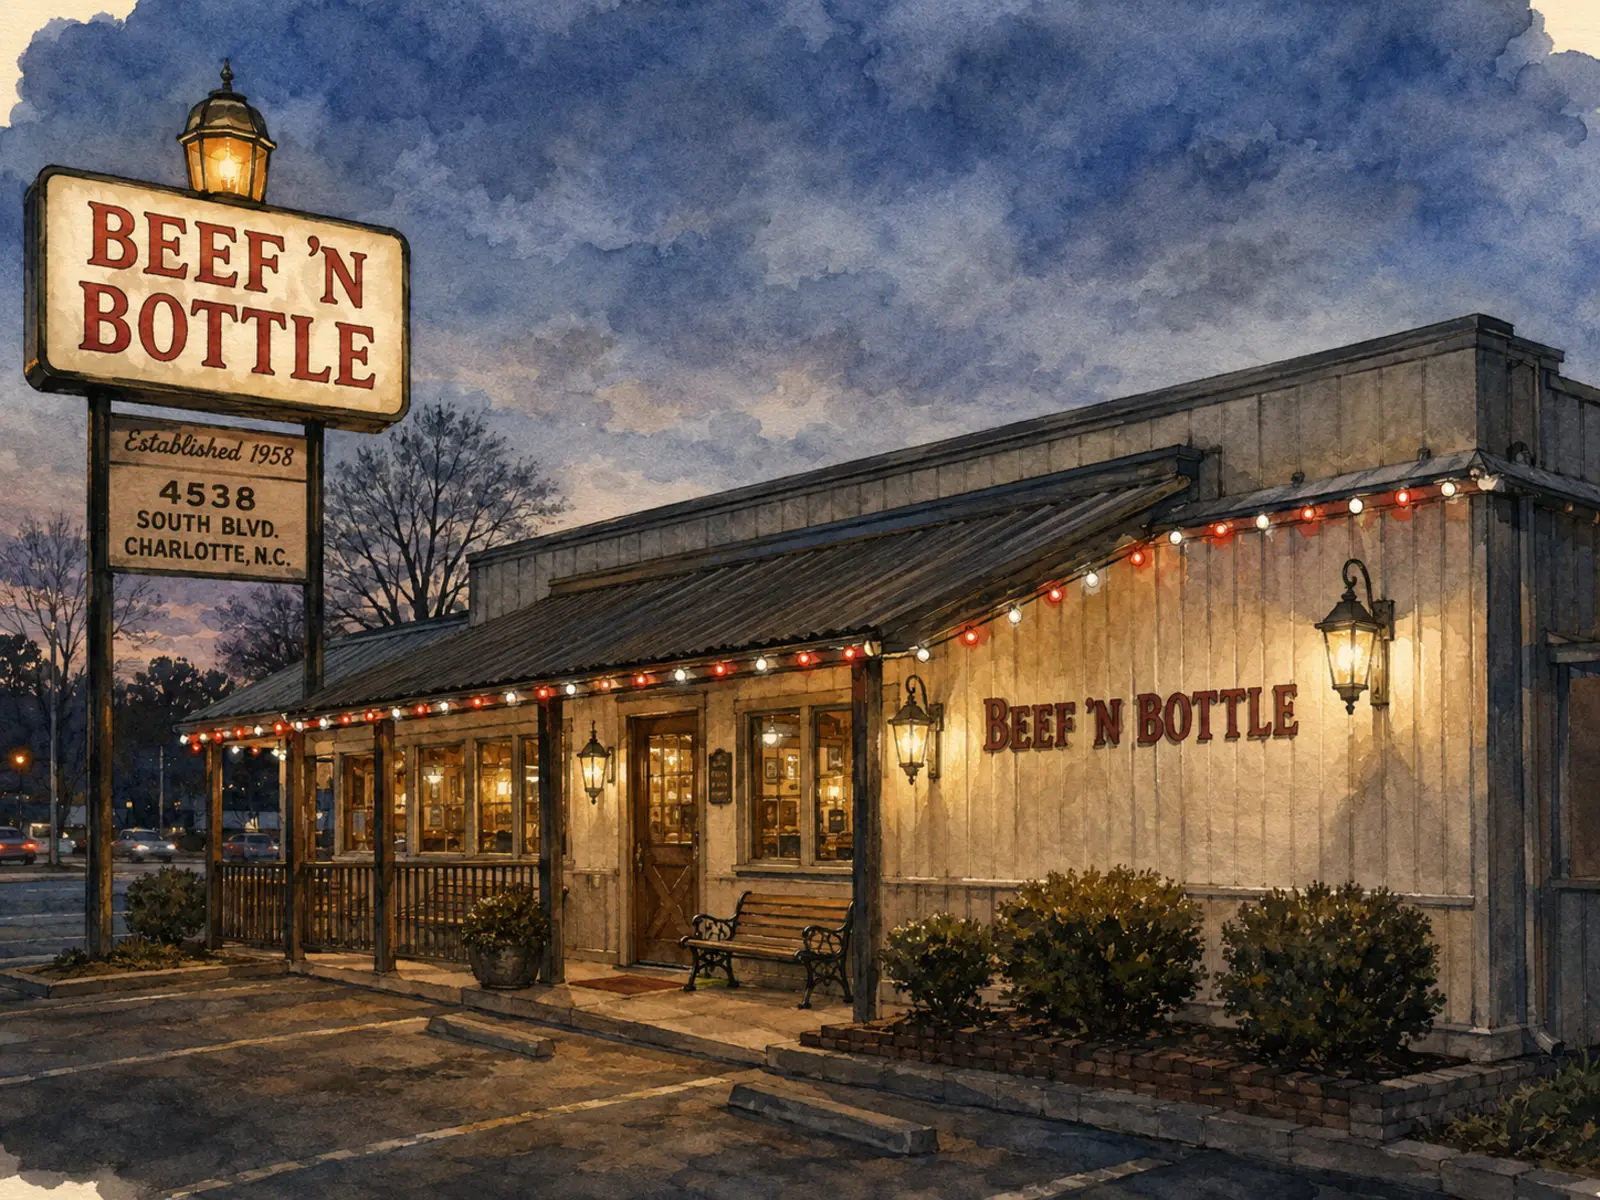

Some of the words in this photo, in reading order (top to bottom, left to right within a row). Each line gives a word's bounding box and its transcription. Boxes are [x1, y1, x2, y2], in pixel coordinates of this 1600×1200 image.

[87, 200, 285, 293] BEEF
[78, 280, 376, 390] BOTTLE
[124, 429, 242, 462] Established
[249, 443, 294, 467] 1958
[158, 479, 256, 511] 4538
[136, 510, 211, 535] SOUTH
[221, 516, 279, 539] BLVD.
[1136, 683, 1299, 747] BOTTLE
